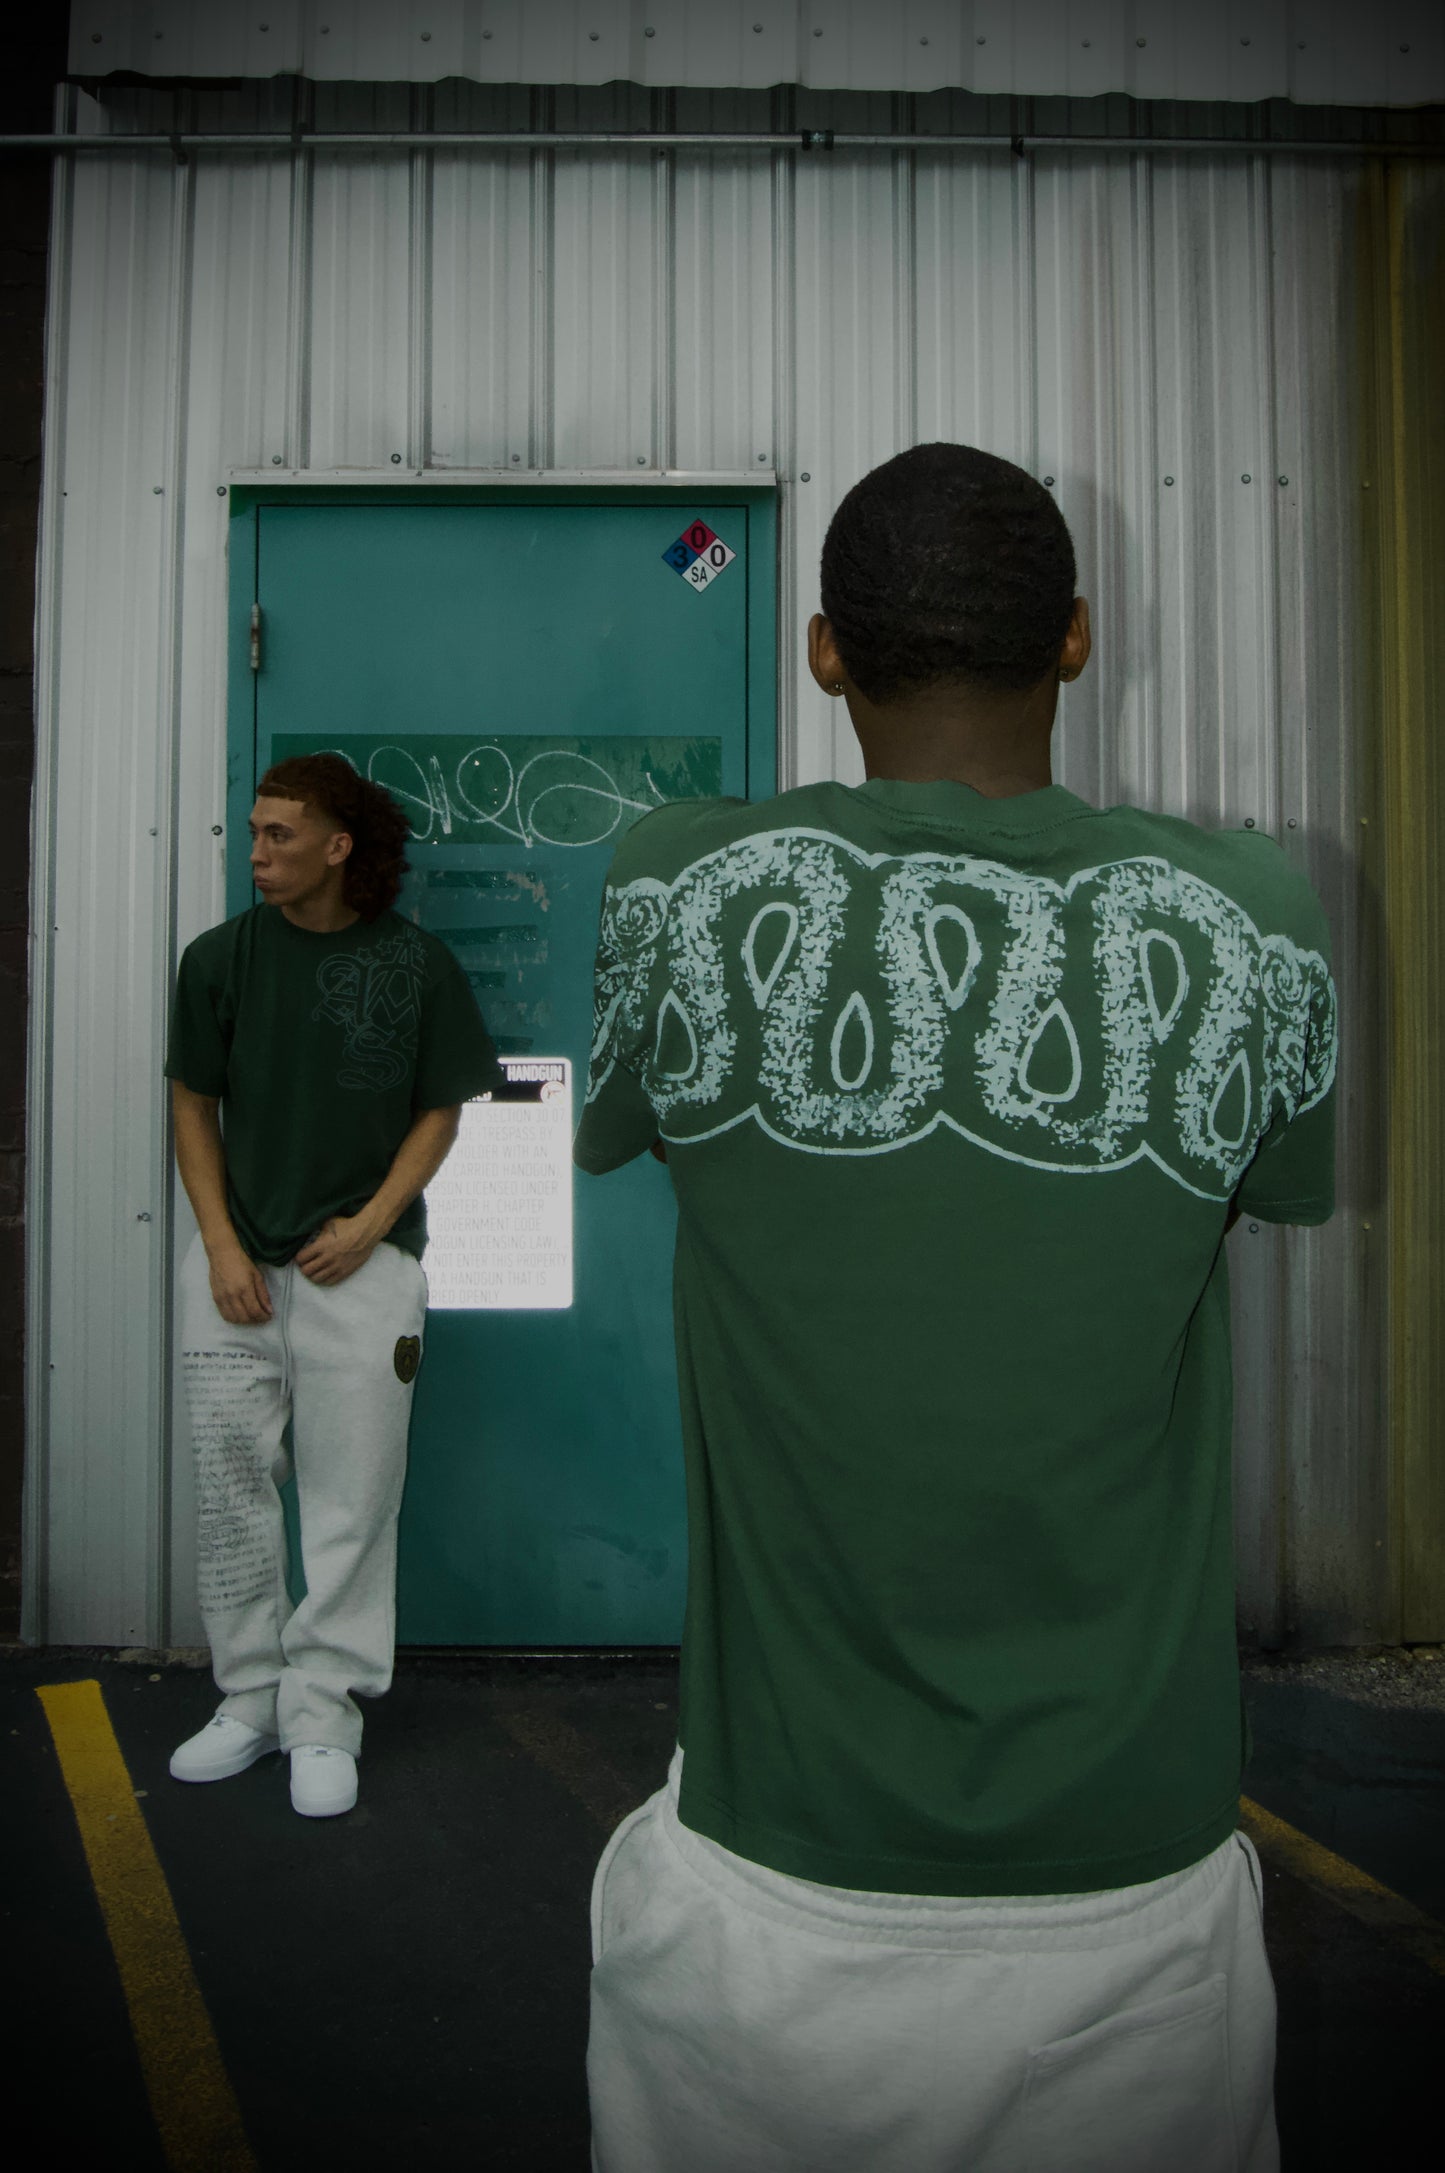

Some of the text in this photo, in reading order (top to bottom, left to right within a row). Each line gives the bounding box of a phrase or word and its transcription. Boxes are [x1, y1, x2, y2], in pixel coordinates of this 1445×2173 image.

[691, 526, 706, 548] 0
[673, 544, 726, 567] 3 0
[691, 566, 708, 583] SA
[507, 1065, 562, 1081] HANDGUN
[470, 1108, 482, 1123] TO
[487, 1108, 531, 1123] SECTION
[460, 1126, 473, 1141] DE
[539, 1126, 553, 1141] BY
[457, 1144, 548, 1159] HOLDER WITH AN
[453, 1162, 499, 1177] CARRIED
[465, 1180, 518, 1195] LICENSED
[521, 1180, 559, 1195] UNDER
[496, 1198, 545, 1213] CHAPTER
[436, 1217, 543, 1232] GOVERNMENT CODE
[470, 1235, 526, 1250] LICENSING
[434, 1253, 453, 1268] NOT
[457, 1253, 488, 1268] ENTER
[492, 1253, 513, 1268] THIS
[517, 1253, 568, 1268] PROPERTY
[440, 1271, 447, 1285] A
[450, 1271, 503, 1286] HANDGUN
[508, 1271, 531, 1286] THAT
[536, 1271, 546, 1286] IS
[459, 1289, 500, 1304] OPENLY
